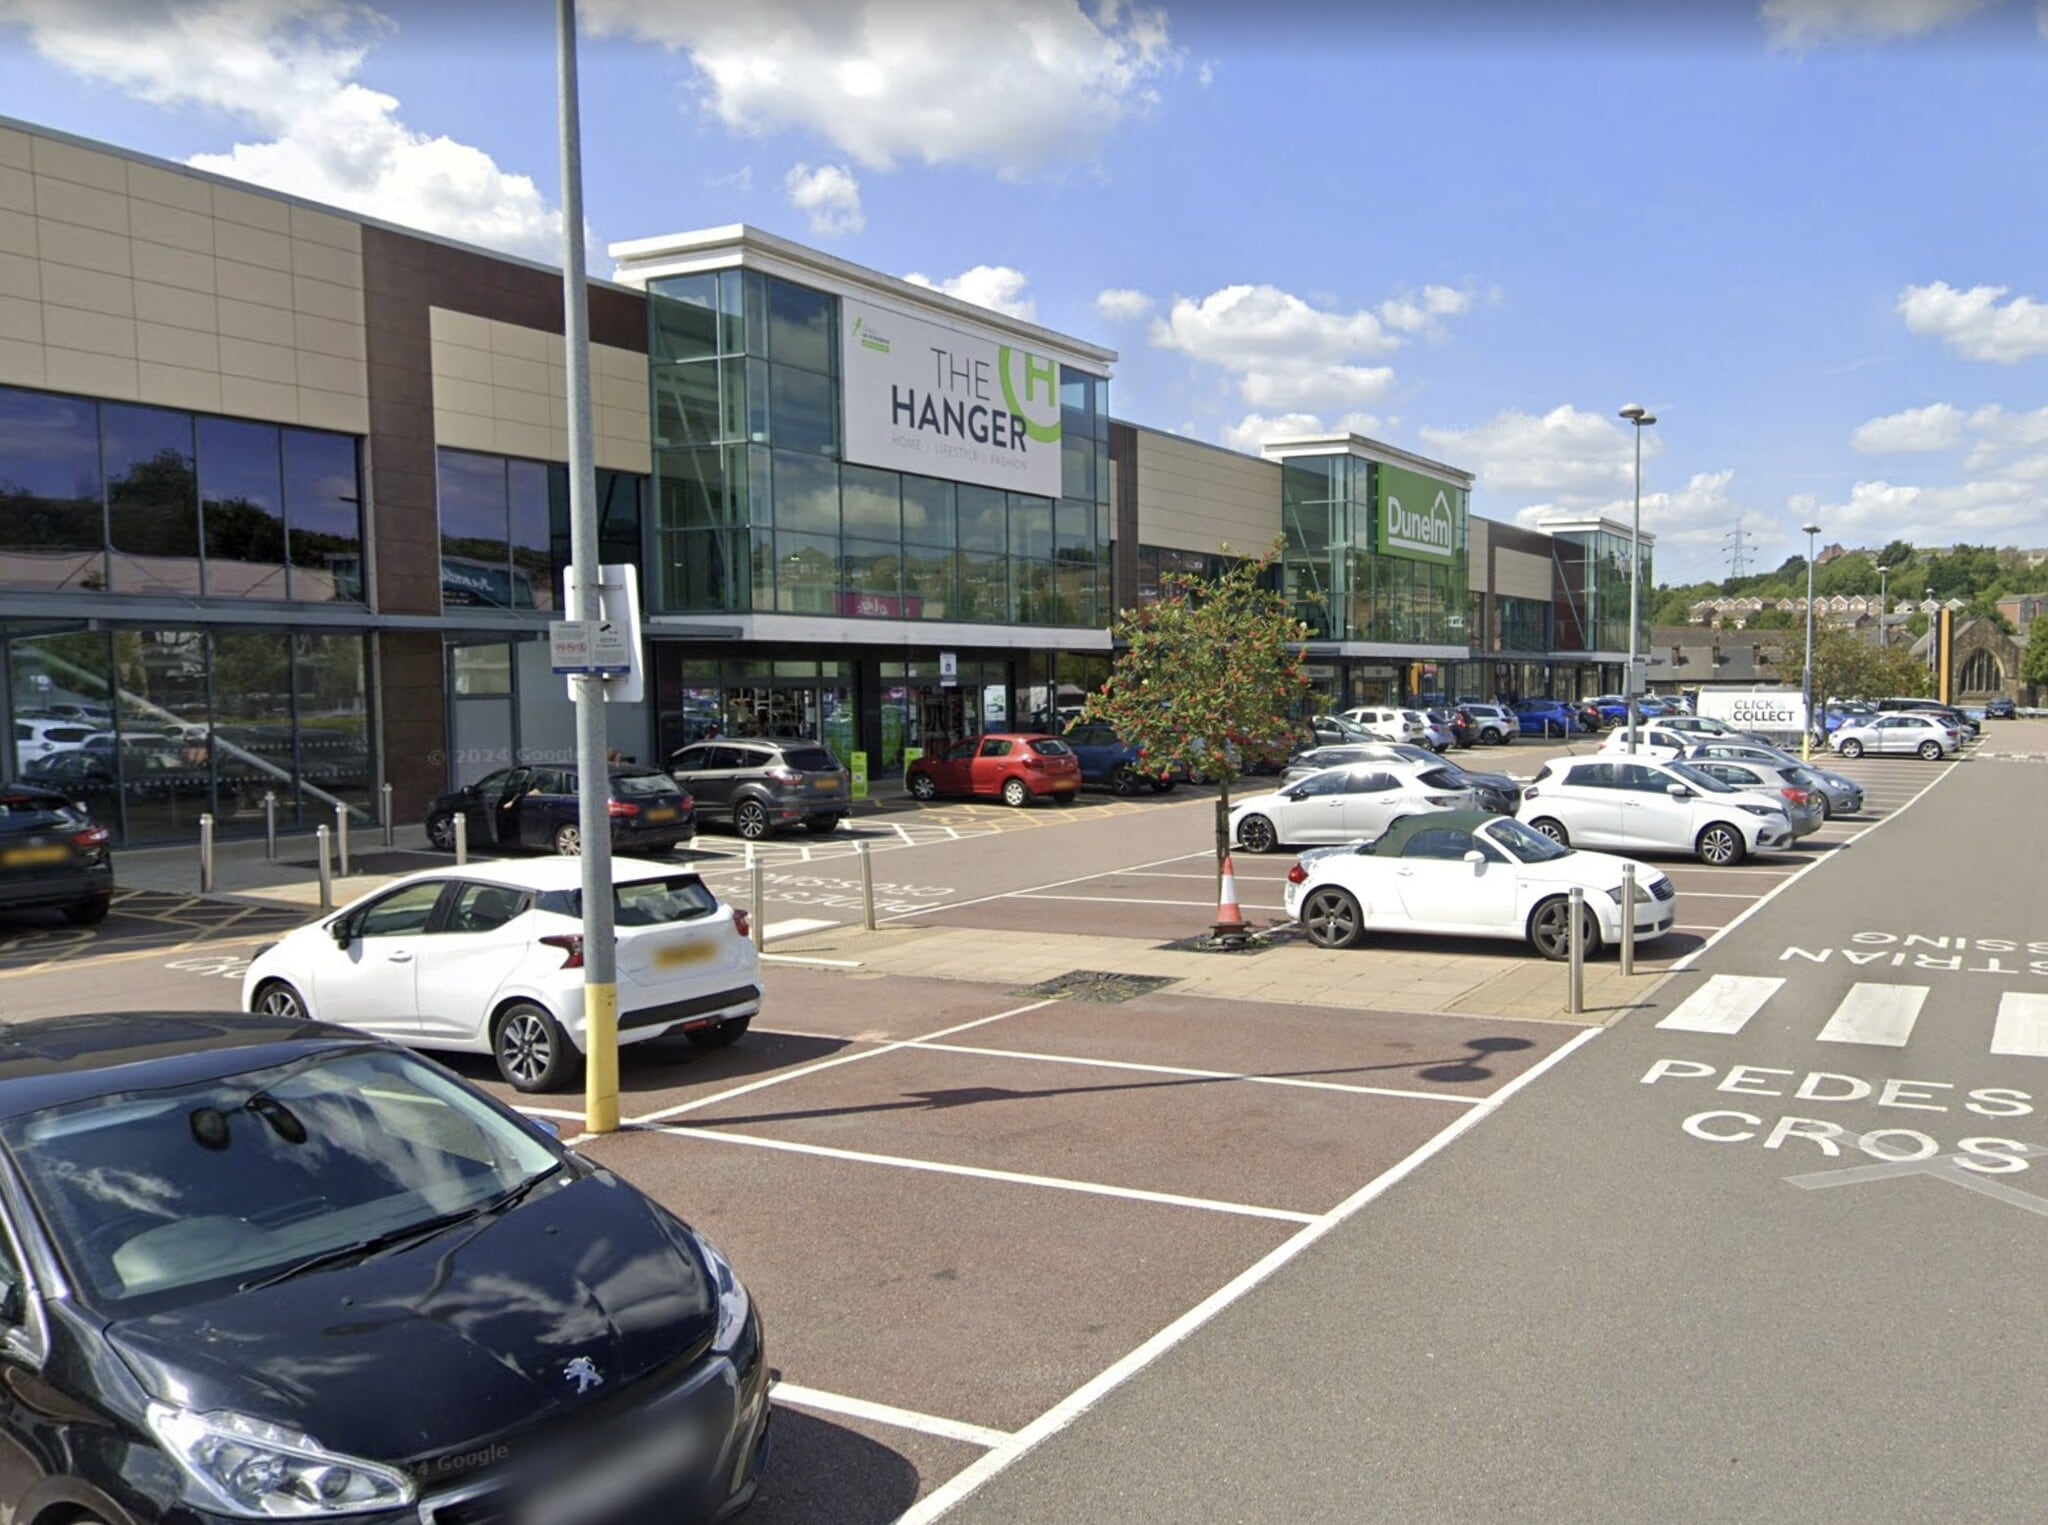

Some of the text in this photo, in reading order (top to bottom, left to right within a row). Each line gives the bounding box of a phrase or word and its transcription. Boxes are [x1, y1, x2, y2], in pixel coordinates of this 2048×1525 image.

[930, 347, 990, 401] THE
[892, 384, 1027, 452] HANGER
[891, 434, 921, 451] HOME
[935, 444, 979, 463] LIFESTYLE
[989, 454, 1027, 471] FASHION
[1388, 496, 1448, 545] Dunelm
[1733, 711, 1793, 722] COLLECT
[1734, 699, 1774, 710] CLICK
[1640, 1059, 2034, 1117] PEDES
[1682, 1110, 2031, 1174] CROS
